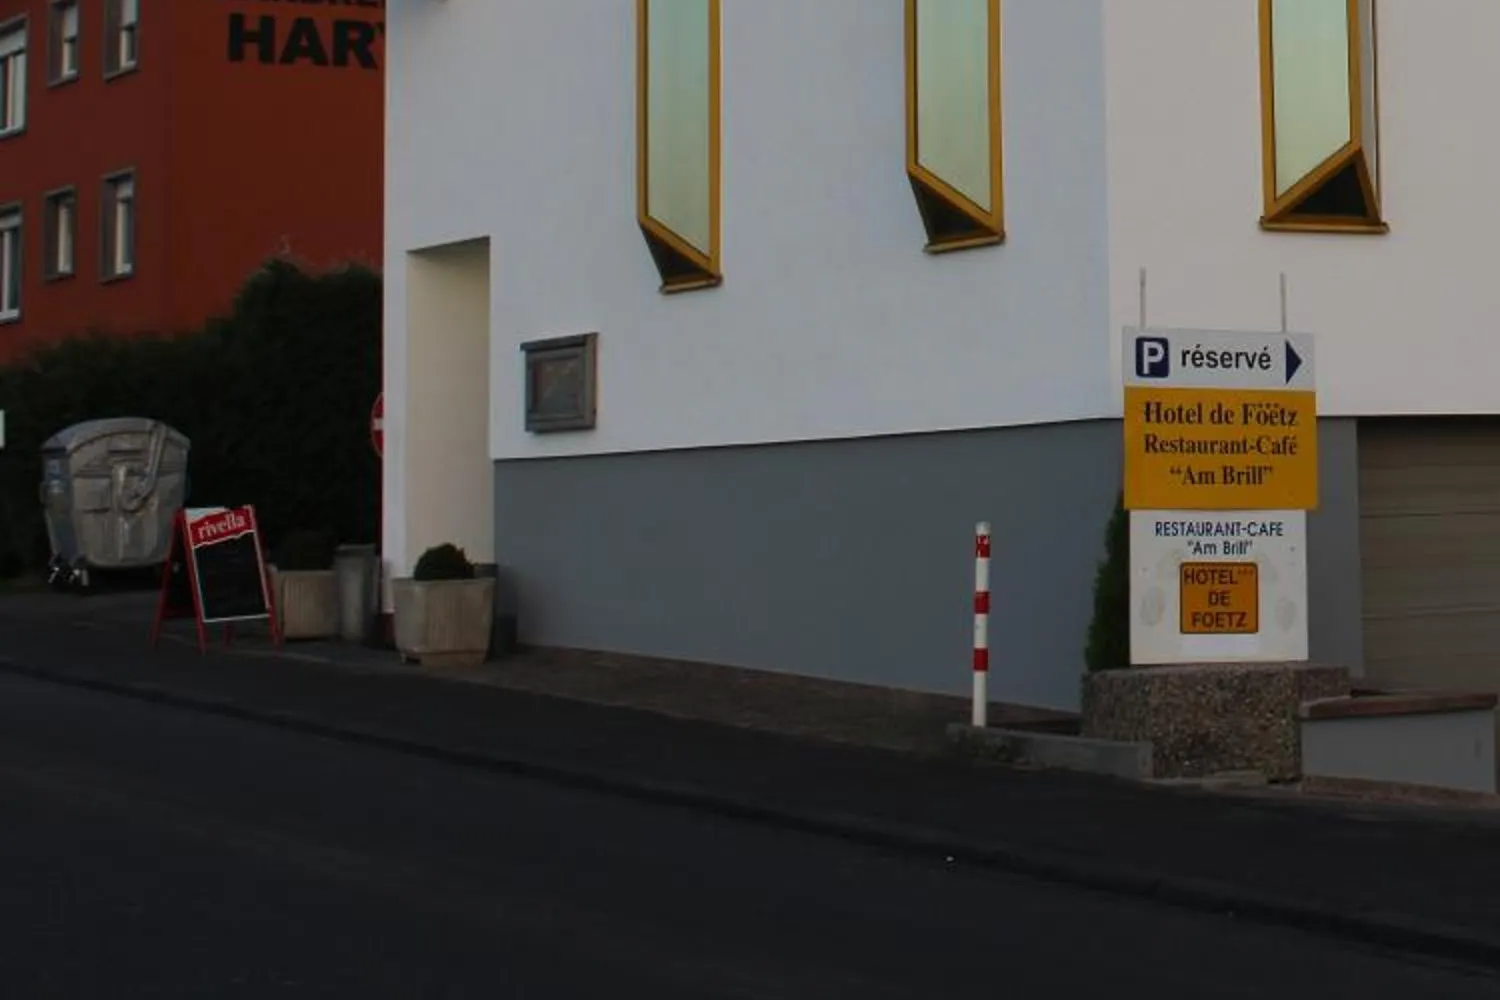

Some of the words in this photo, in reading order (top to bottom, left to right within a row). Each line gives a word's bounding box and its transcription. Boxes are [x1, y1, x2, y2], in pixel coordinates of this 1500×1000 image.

[227, 13, 385, 70] HAR
[1143, 341, 1164, 375] P
[1181, 344, 1272, 370] réservé
[1144, 402, 1204, 425] Hotel
[1209, 403, 1235, 425] de
[1144, 434, 1298, 456] Restaurant-Café
[198, 513, 246, 540] rivella
[1155, 521, 1284, 537] RESTAURANT-CAFE
[1184, 568, 1239, 586] HOTEL
[1208, 592, 1231, 606] DE
[1191, 611, 1248, 628] FOETZ
